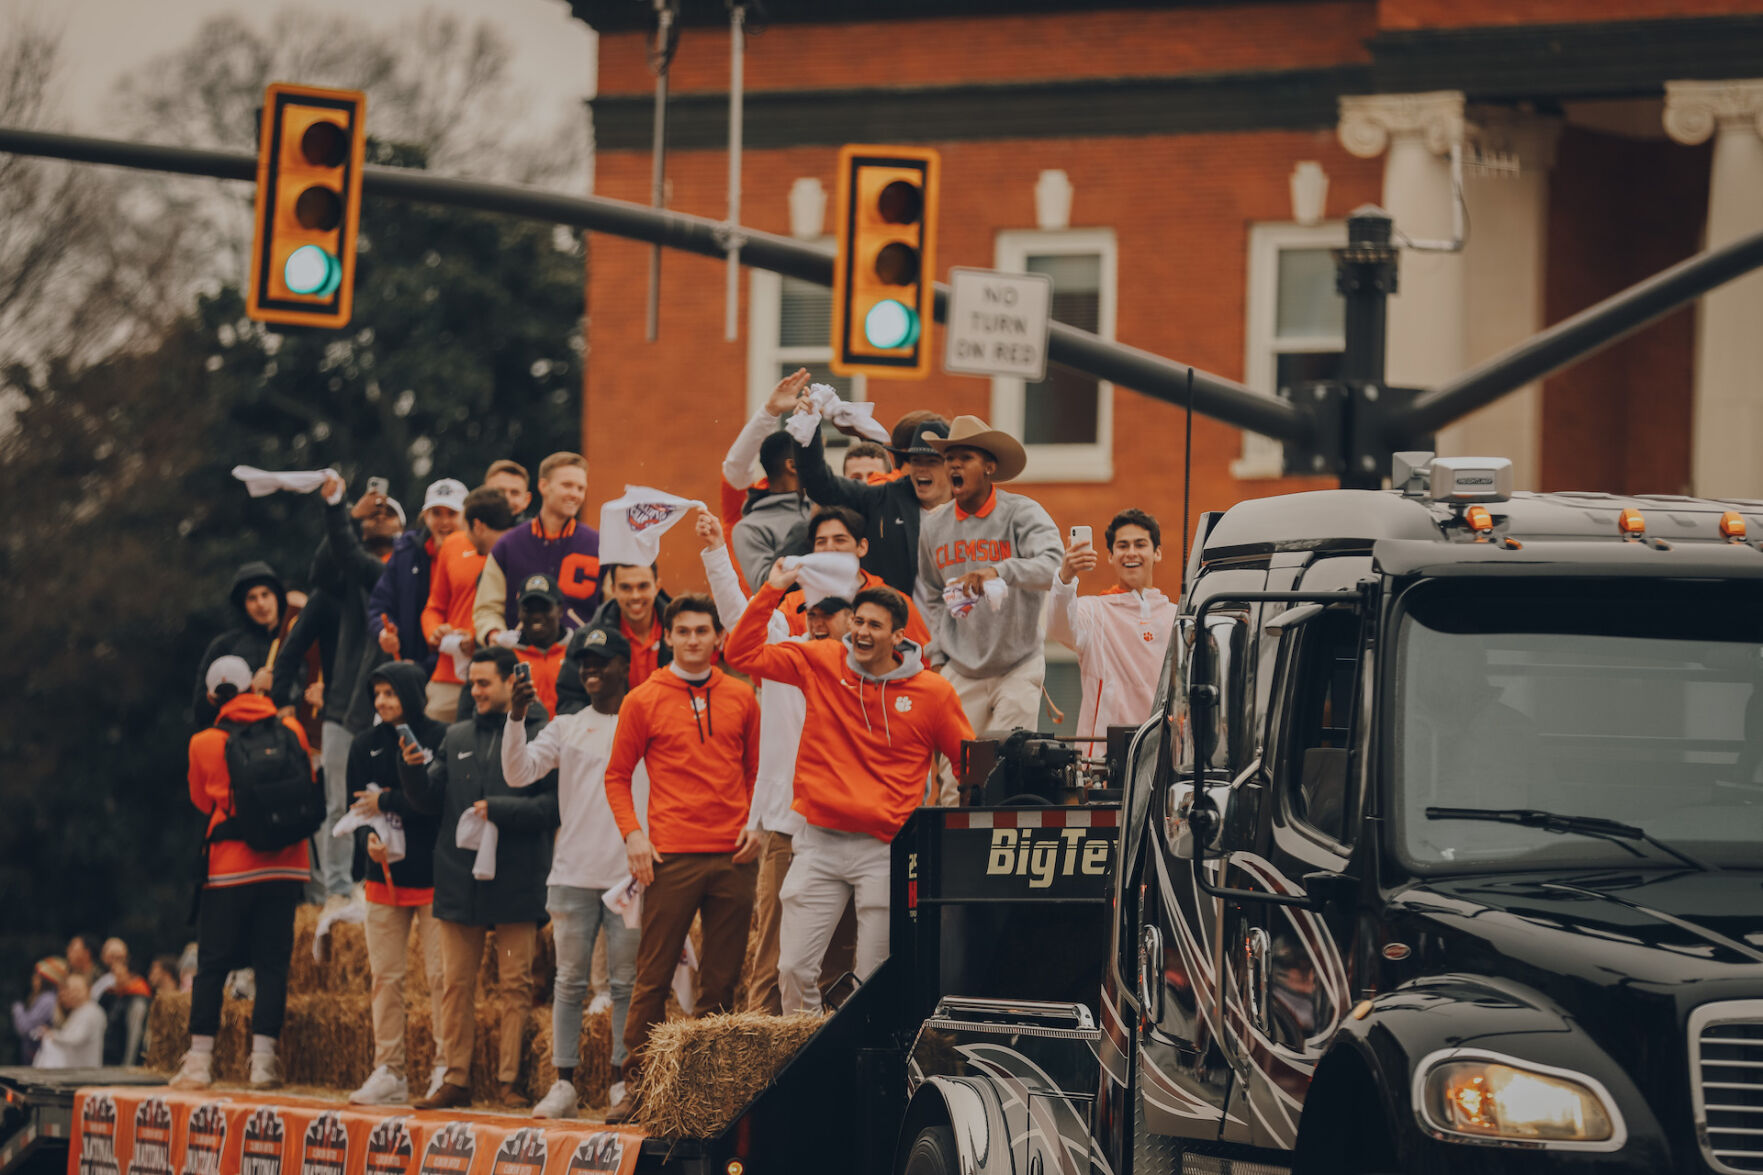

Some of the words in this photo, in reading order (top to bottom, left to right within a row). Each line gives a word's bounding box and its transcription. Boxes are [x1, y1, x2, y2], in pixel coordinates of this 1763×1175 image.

[983, 285, 1018, 307] NO
[969, 311, 1028, 336] TURN
[955, 338, 985, 360] ON
[993, 341, 1037, 366] RED
[935, 539, 1012, 570] CLEMSON
[558, 552, 601, 600] C
